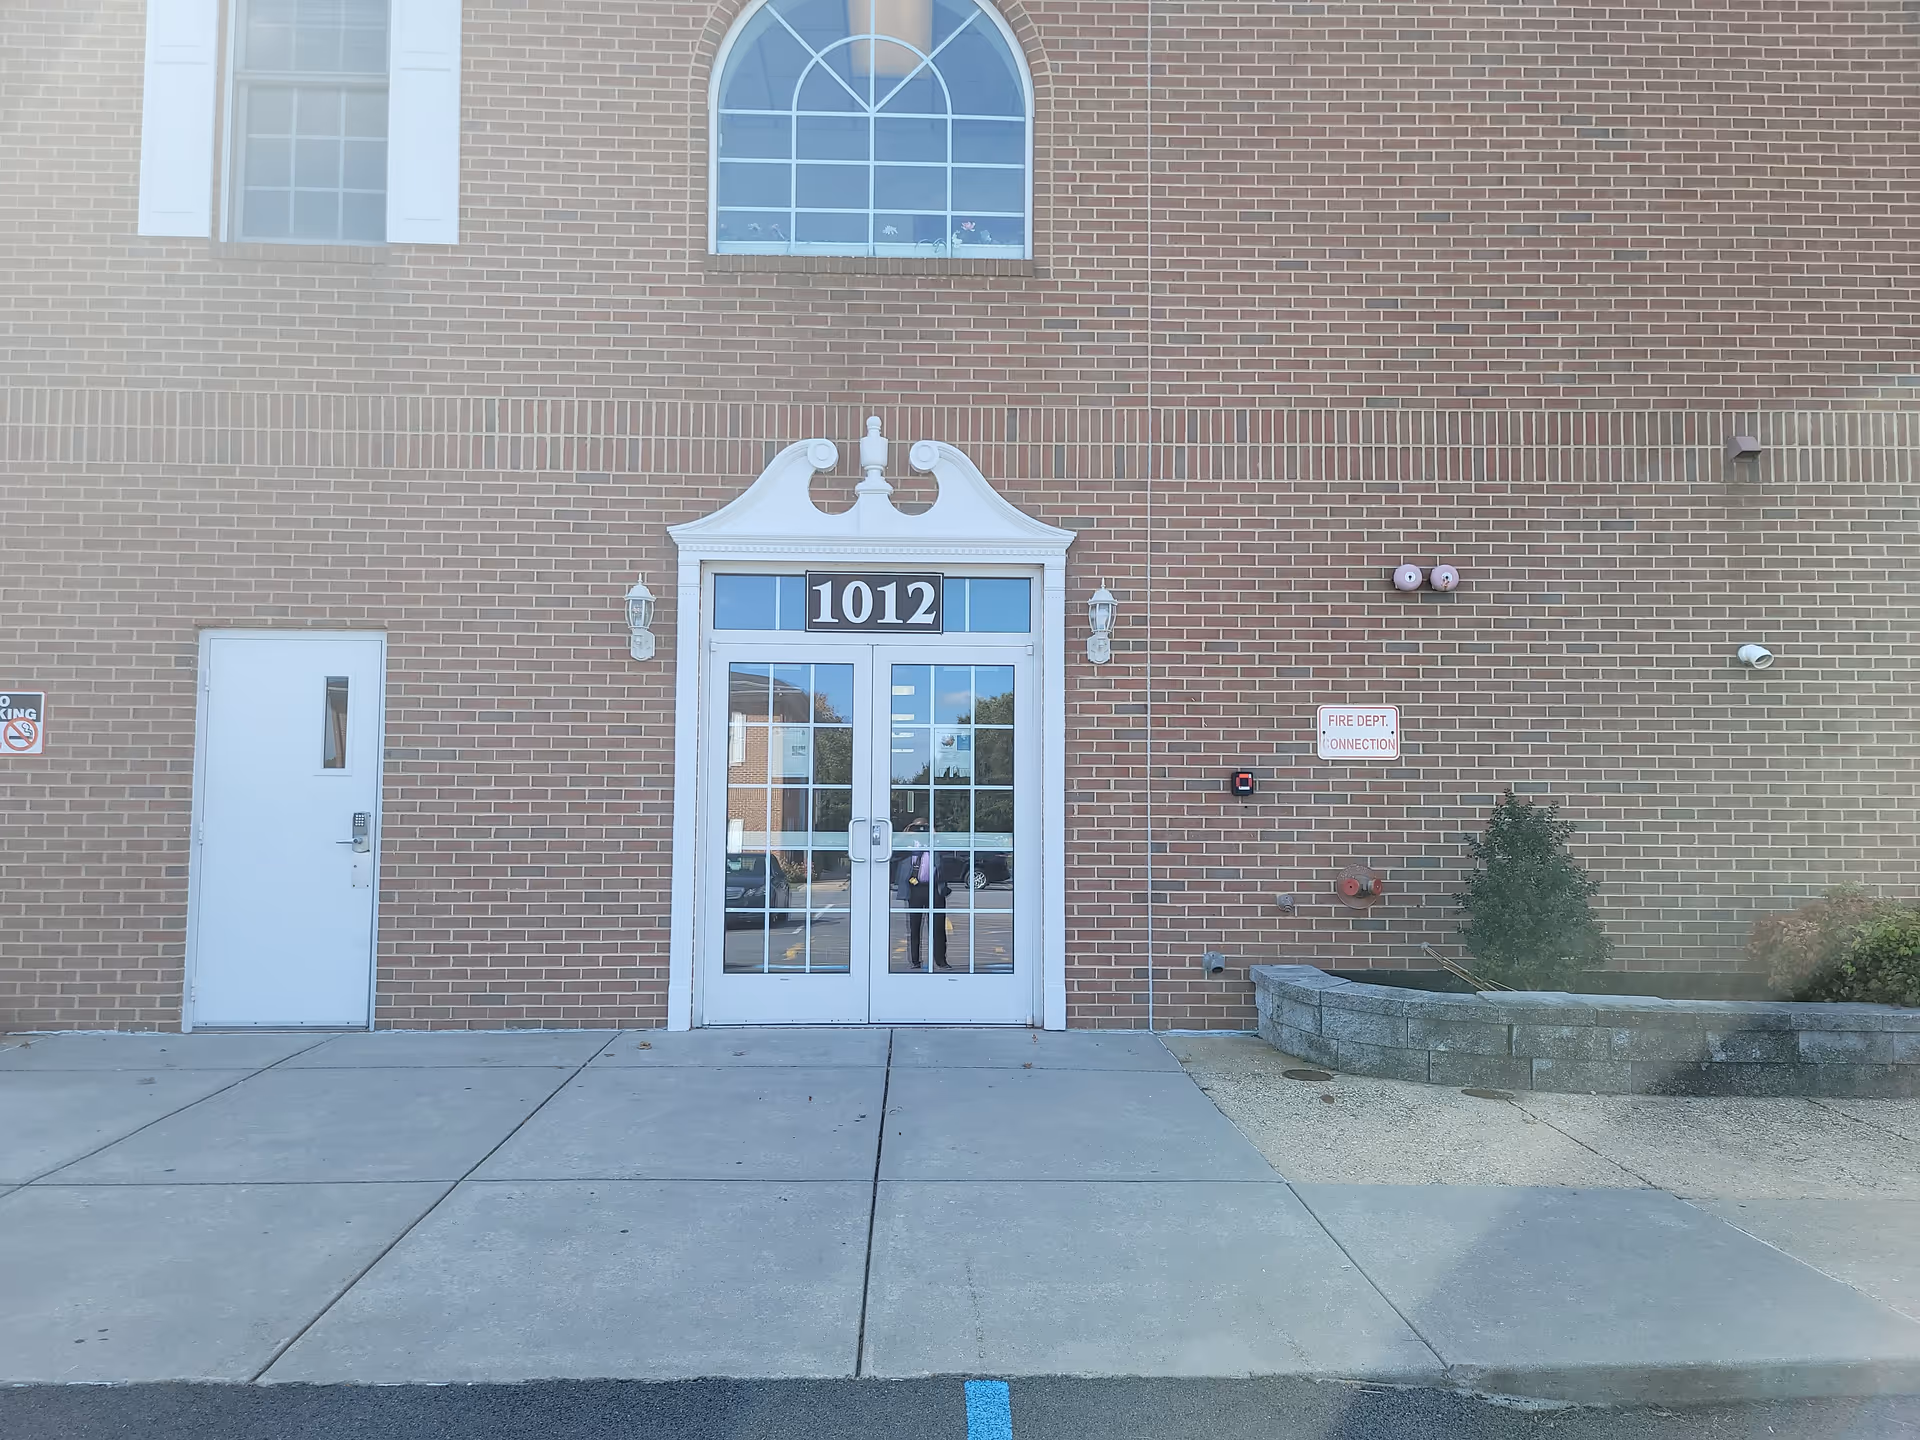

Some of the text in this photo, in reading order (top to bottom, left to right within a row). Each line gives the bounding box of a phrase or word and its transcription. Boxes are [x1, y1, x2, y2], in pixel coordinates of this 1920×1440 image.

[812, 580, 937, 625] 1012
[1328, 714, 1389, 727] FIRE DEPT.
[1322, 738, 1396, 751] CONNECTION
